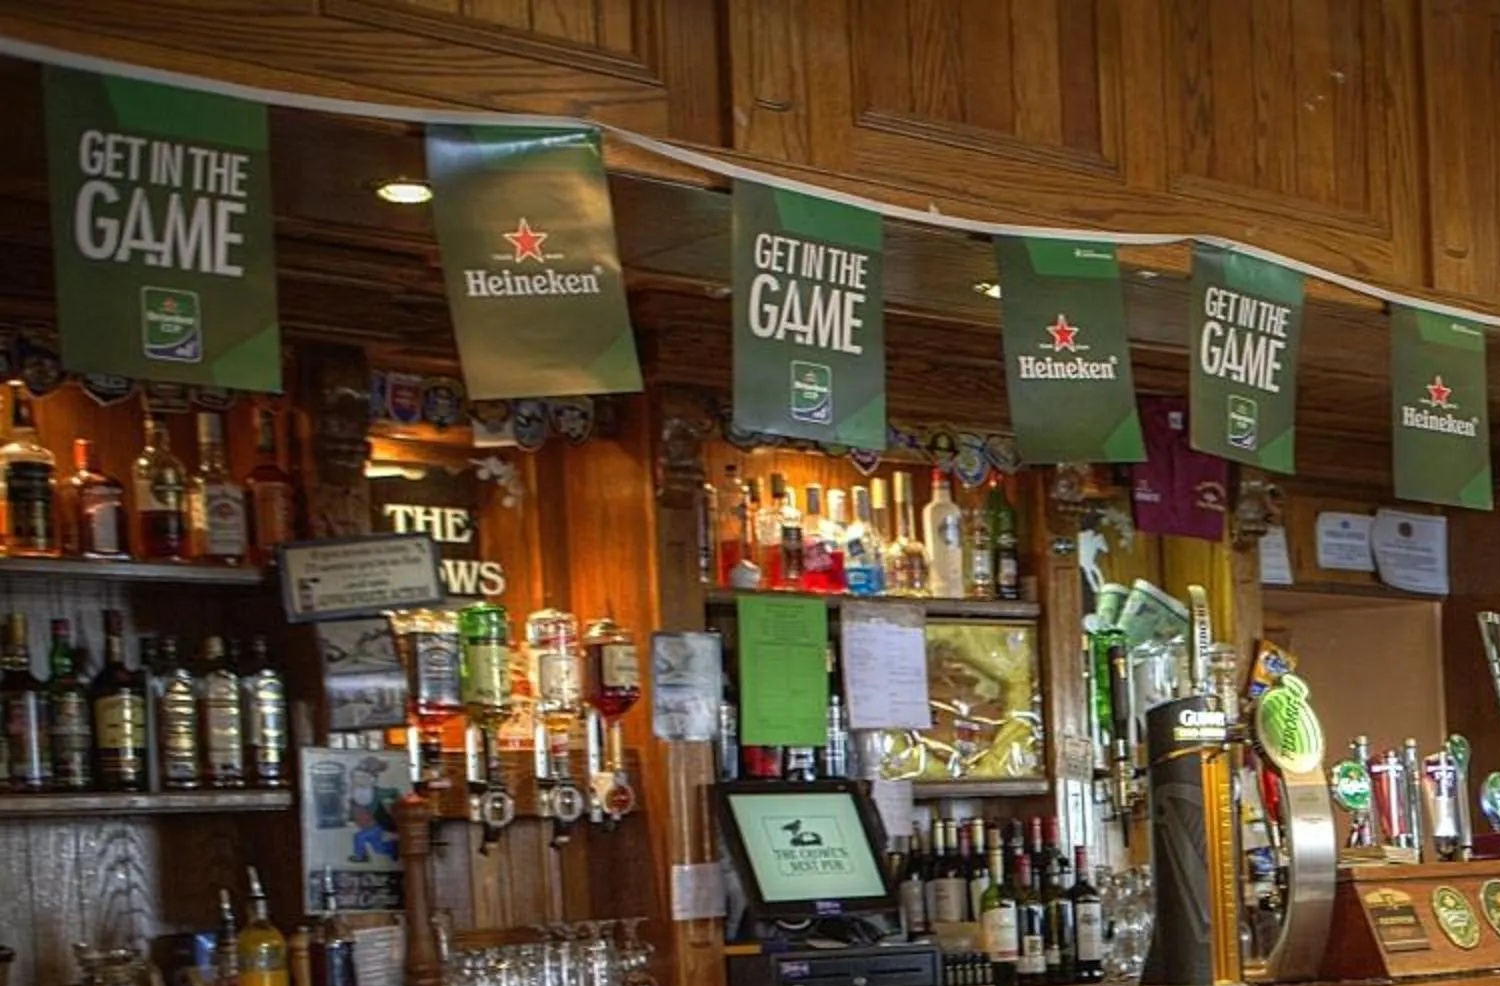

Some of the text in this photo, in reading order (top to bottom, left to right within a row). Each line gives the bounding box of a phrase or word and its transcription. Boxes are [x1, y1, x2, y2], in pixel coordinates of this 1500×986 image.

[79, 129, 250, 197] GET IN THE
[75, 180, 247, 277] GAME
[464, 267, 601, 296] Heineken
[755, 233, 868, 289] GET IN THE
[749, 273, 866, 354] GAME
[1205, 287, 1292, 338] GET IN THE
[1018, 355, 1115, 379] Heineken
[1201, 321, 1286, 393] GAME
[1402, 405, 1476, 436] Heineken
[383, 503, 474, 543] THE
[773, 849, 797, 860] THE
